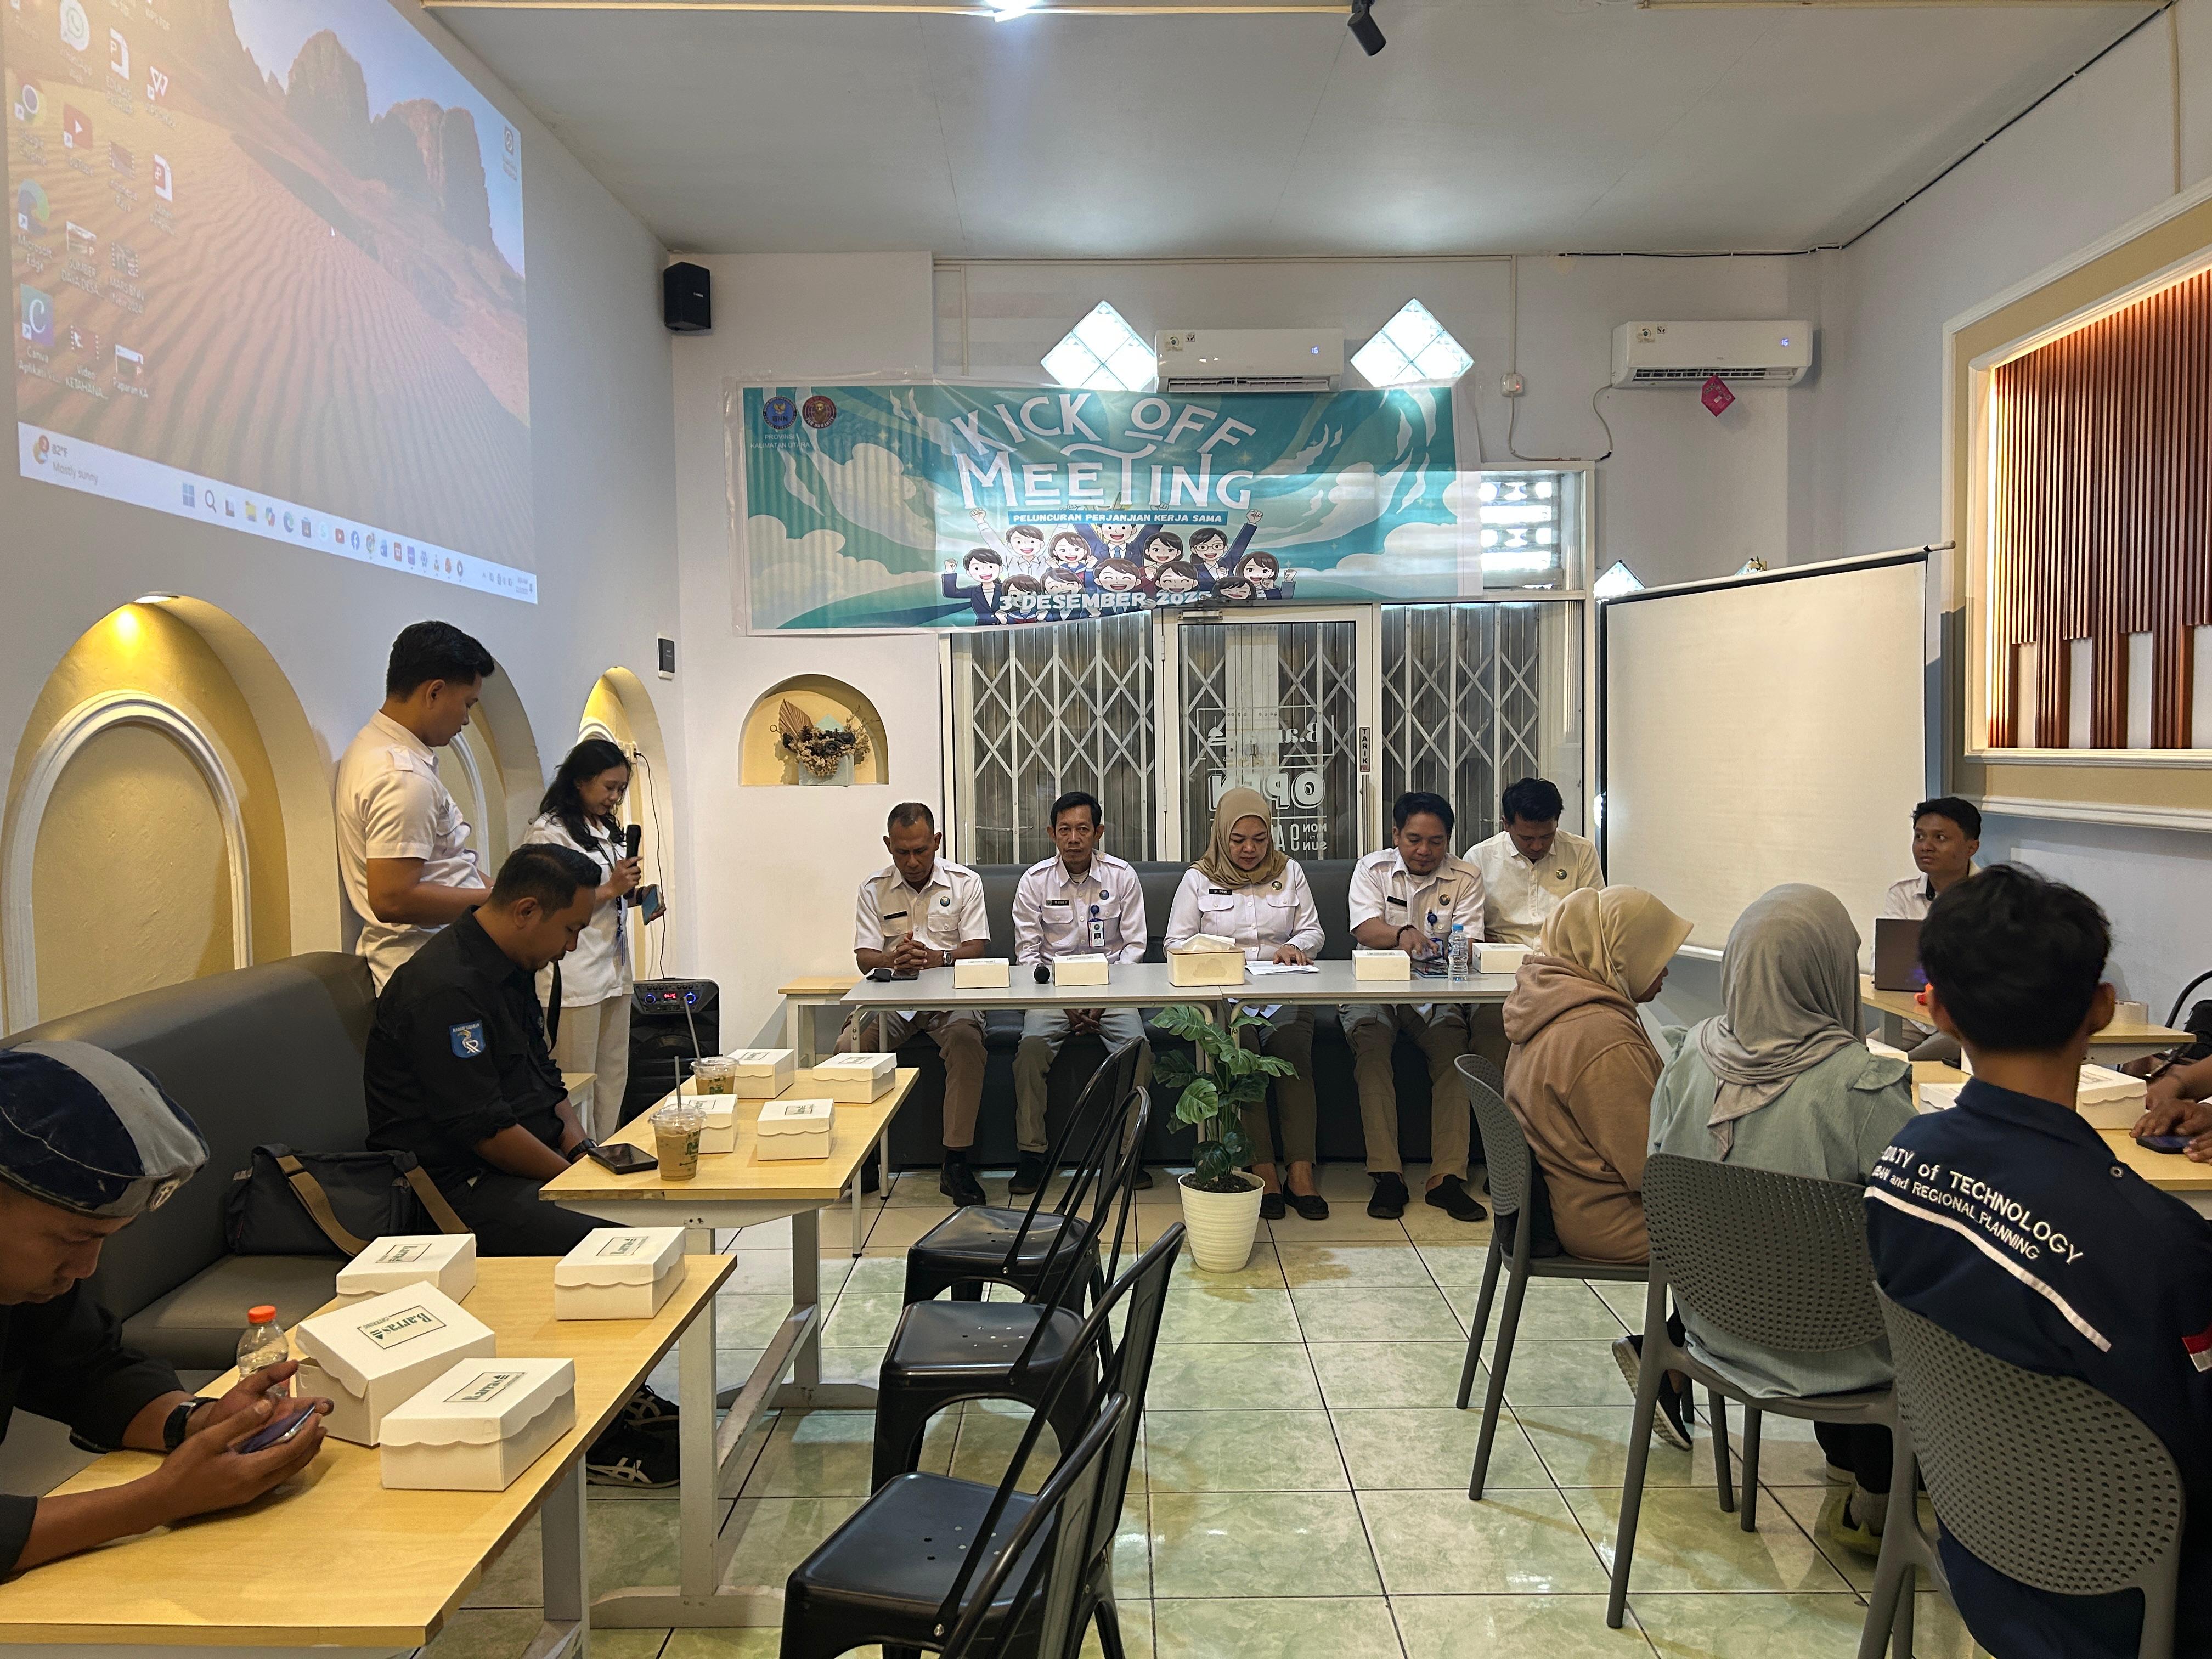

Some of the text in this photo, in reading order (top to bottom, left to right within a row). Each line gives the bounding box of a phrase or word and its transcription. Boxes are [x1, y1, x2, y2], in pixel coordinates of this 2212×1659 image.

[27, 346, 48, 363] Canva
[950, 393, 1256, 455] KICK OFF
[53, 461, 76, 479] Mostly
[955, 443, 1254, 510] MEETING
[1013, 513, 1082, 522] PELUNCURAN
[1085, 514, 1151, 522] PERJANJIAN
[1154, 515, 1189, 523] KERJA
[999, 596, 1013, 611] 3
[1021, 591, 1147, 611] DESEMBER
[1889, 1175, 1909, 1190] and
[1911, 1181, 1975, 1220] REGIONAL
[1974, 1211, 2041, 1260] PLANNING
[1918, 1164, 1940, 1181] of
[1949, 1170, 2084, 1265] TECHNOLOGY
[381, 1312, 432, 1334] B.arras
